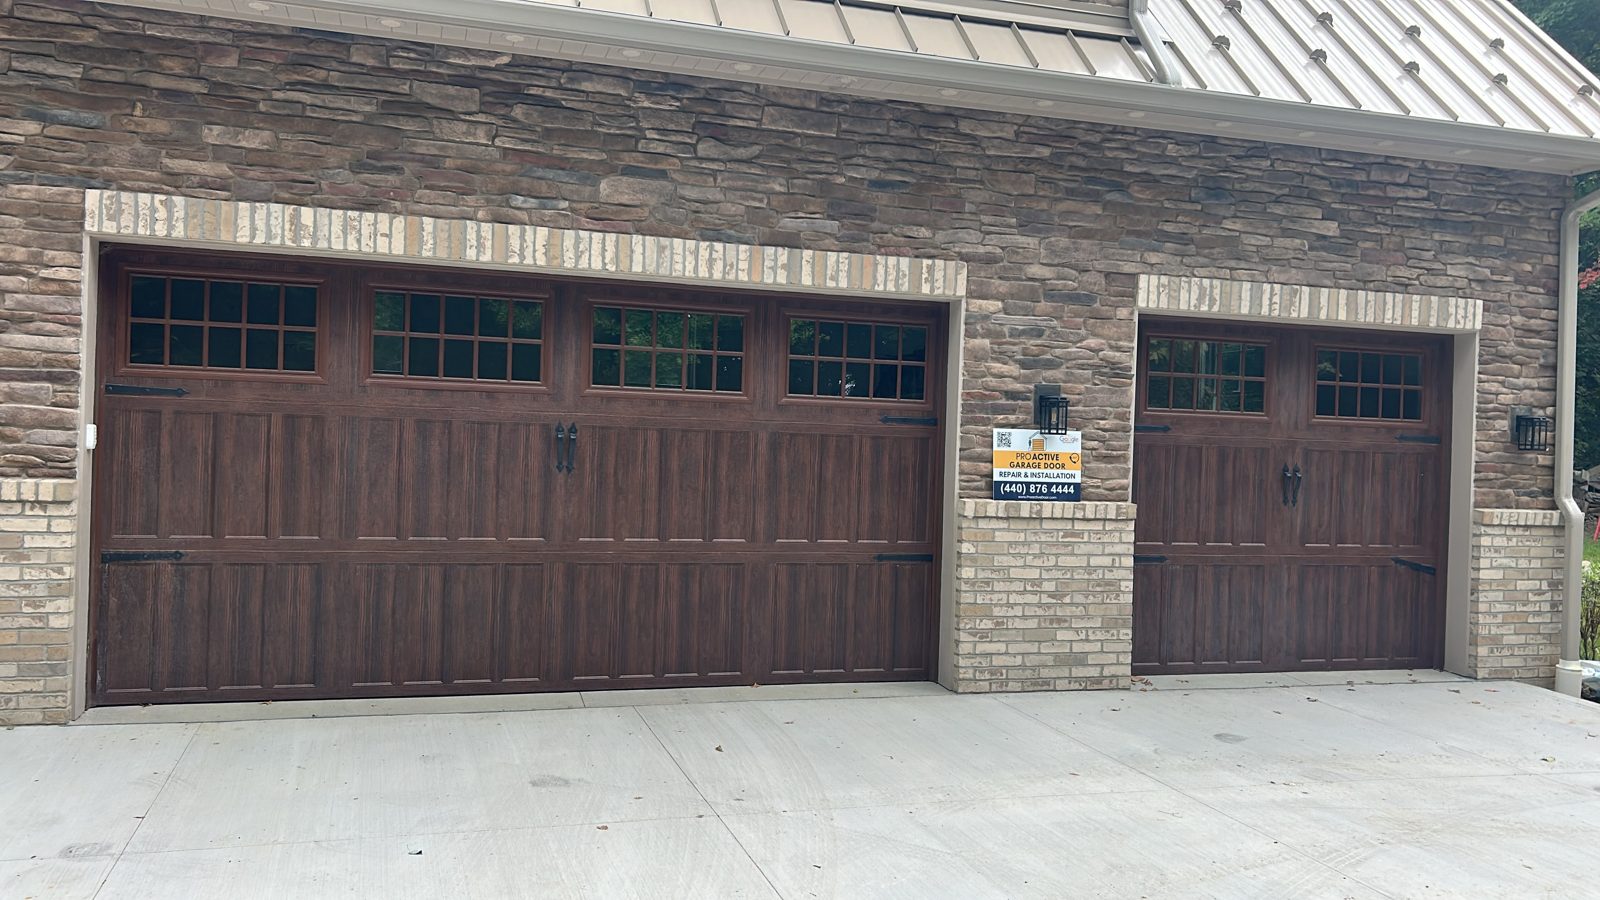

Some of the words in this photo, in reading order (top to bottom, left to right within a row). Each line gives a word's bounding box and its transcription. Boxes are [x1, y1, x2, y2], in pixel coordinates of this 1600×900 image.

[1016, 453, 1059, 461] PROACTIVE
[1009, 461, 1041, 469] GARAGE
[1044, 462, 1066, 470] DOOR
[999, 471, 1022, 479] REPAIR
[1030, 472, 1076, 480] INSTALLATION
[1000, 483, 1026, 495] (440)
[1029, 484, 1048, 493] 876
[1050, 485, 1075, 494] 4444
